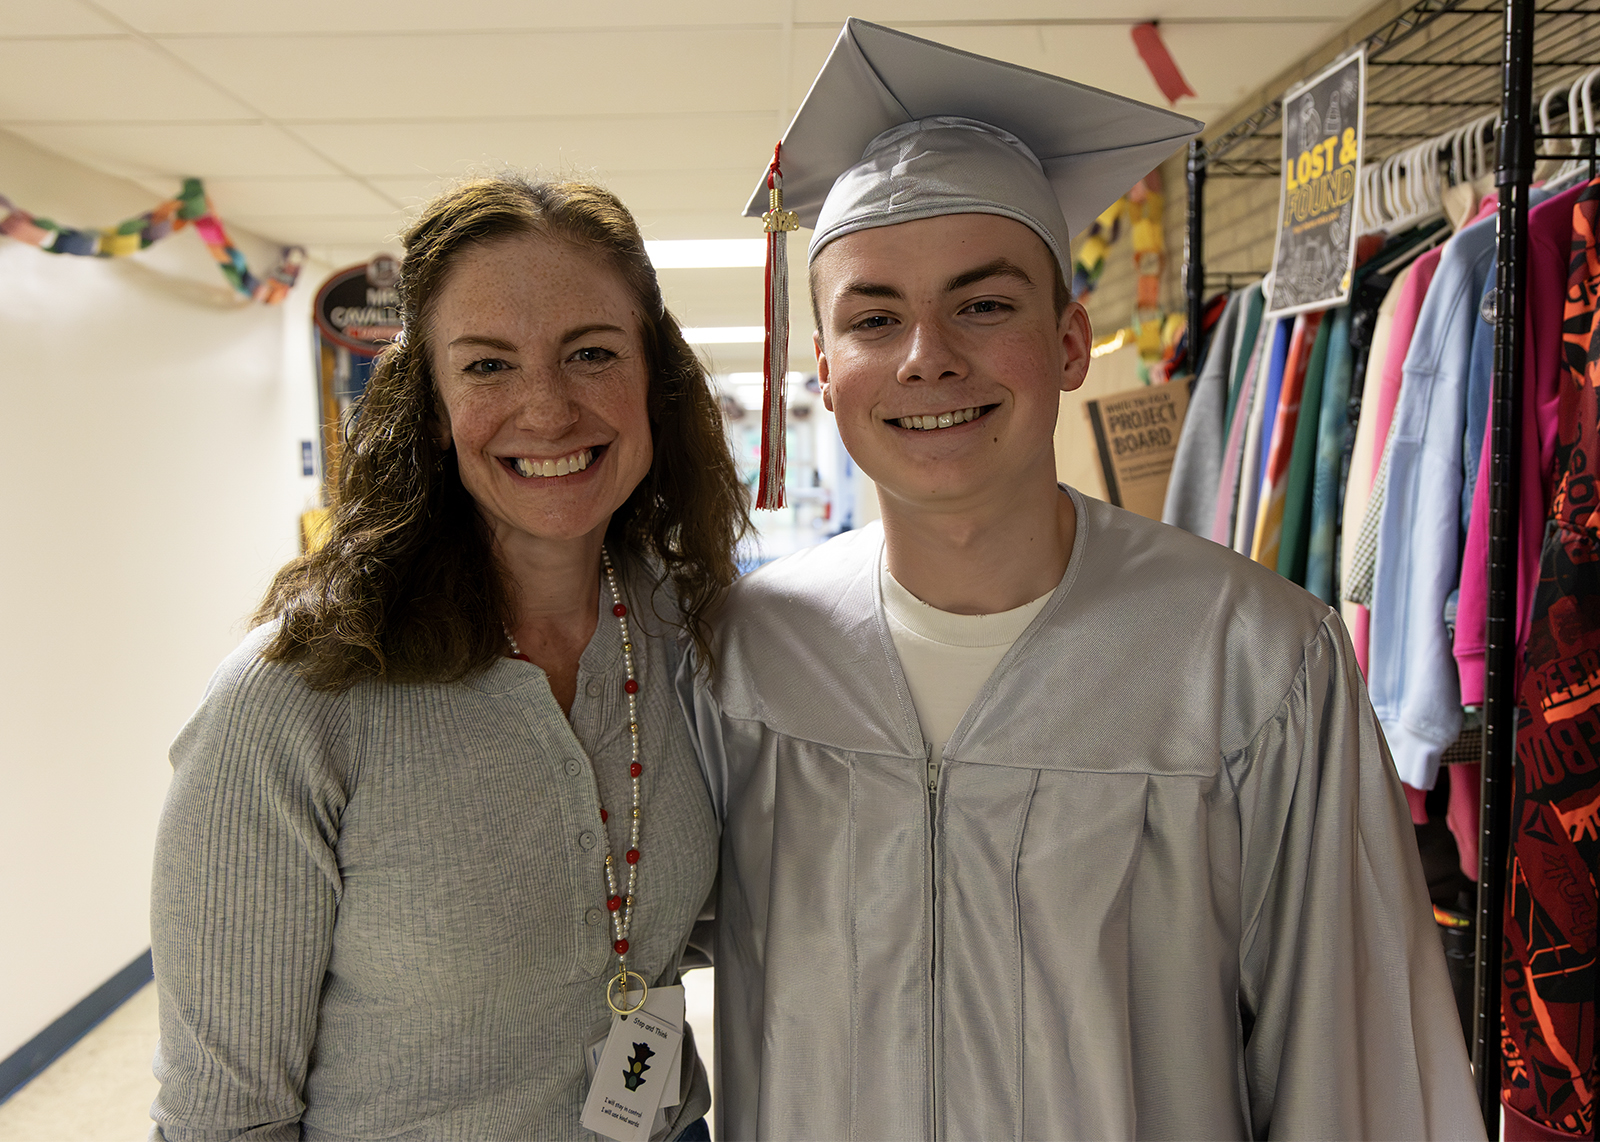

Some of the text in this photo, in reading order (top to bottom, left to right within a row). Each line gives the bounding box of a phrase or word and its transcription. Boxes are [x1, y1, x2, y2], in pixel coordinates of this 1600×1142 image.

[1287, 126, 1357, 190] LOST &
[1284, 164, 1355, 227] FOUND
[330, 306, 402, 328] CAVALL
[1109, 402, 1176, 433] PROJECT
[1115, 427, 1172, 455] BOARD
[633, 1017, 668, 1039] Stop and Think
[614, 1102, 624, 1111] stay
[628, 1108, 643, 1118] control
[619, 1113, 628, 1123] kind
[628, 1119, 640, 1128] words
